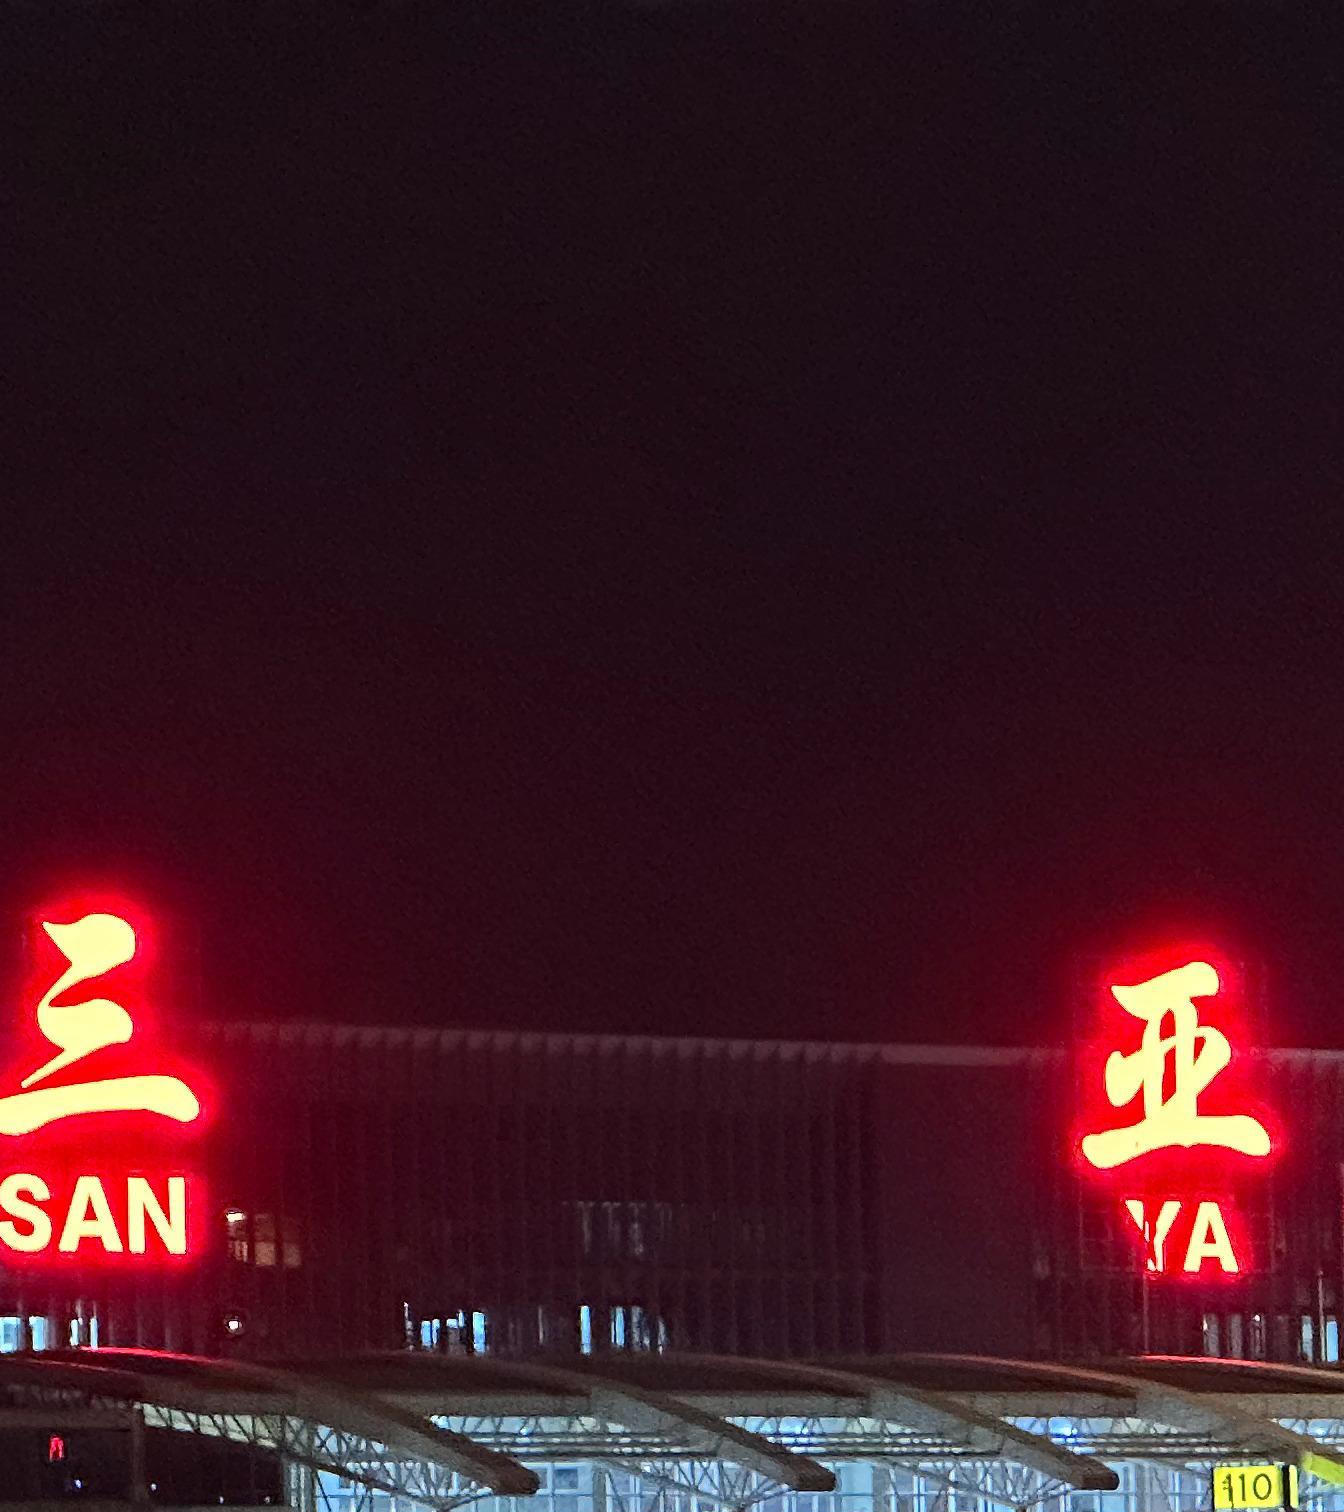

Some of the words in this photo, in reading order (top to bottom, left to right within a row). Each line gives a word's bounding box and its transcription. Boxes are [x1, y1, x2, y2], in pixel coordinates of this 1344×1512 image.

[1081, 961, 1271, 1169] 亚
[1124, 1199, 1239, 1273] YA
[1223, 1473, 1272, 1501] 110
